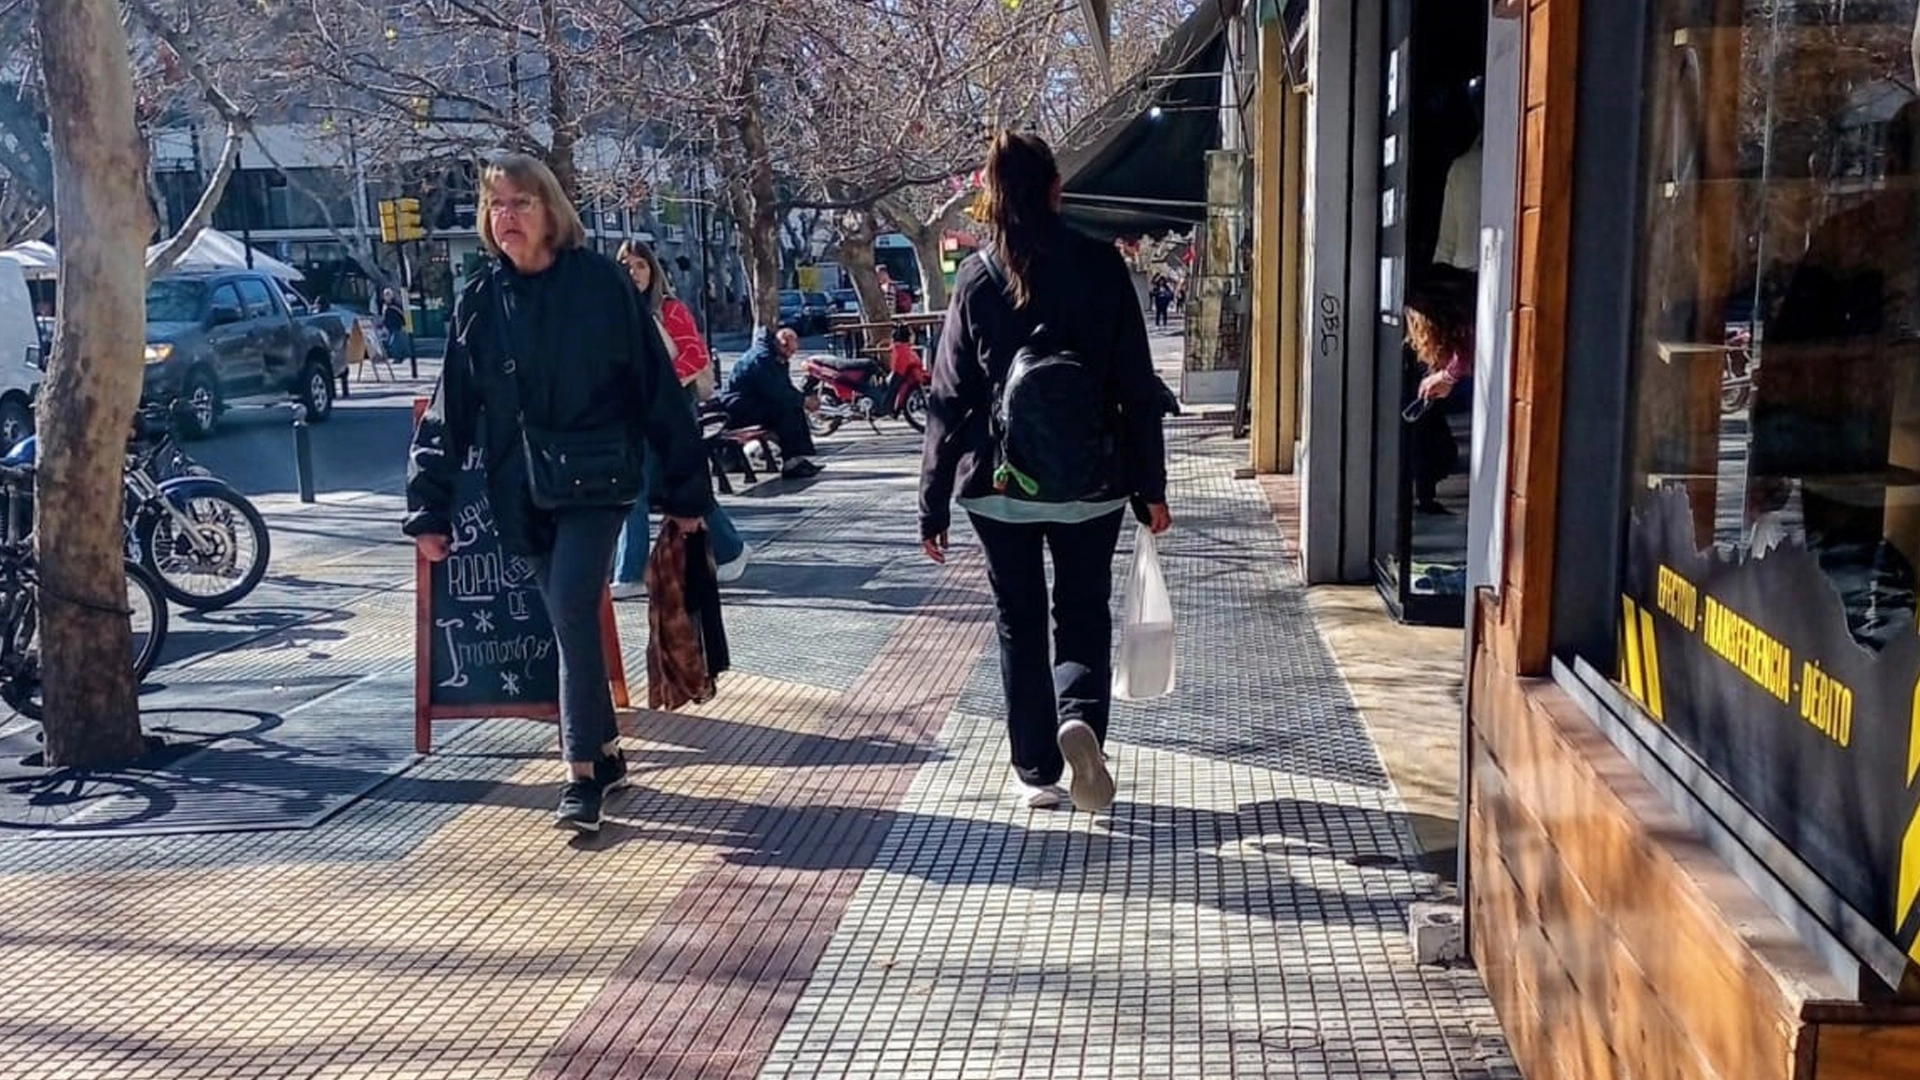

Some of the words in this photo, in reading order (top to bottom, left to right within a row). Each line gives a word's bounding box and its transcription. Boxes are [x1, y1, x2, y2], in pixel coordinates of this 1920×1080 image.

[447, 552, 499, 595] ROPA
[508, 590, 529, 616] DE
[1657, 564, 1697, 632] EFECTIVO
[1704, 595, 1791, 704] TRANSFERENCIA
[1801, 659, 1852, 747] DÉBITO
